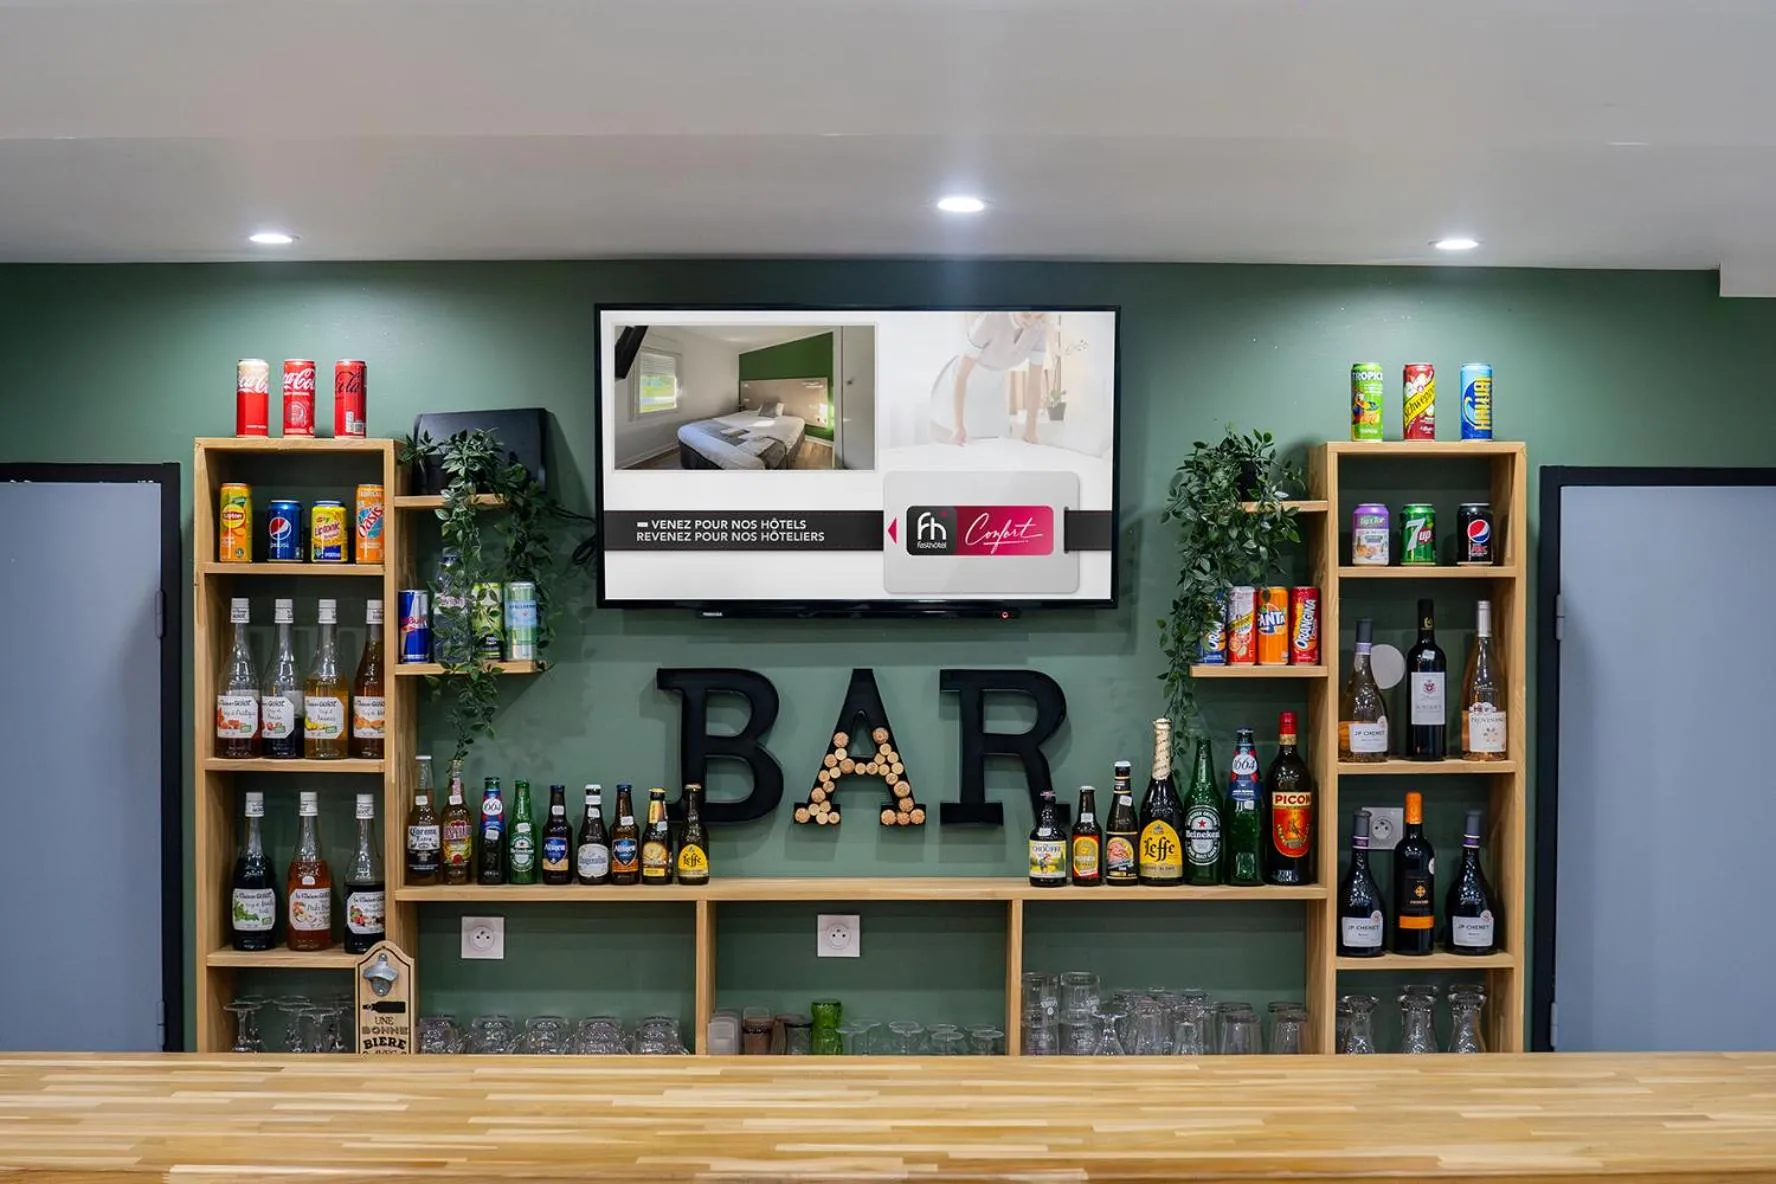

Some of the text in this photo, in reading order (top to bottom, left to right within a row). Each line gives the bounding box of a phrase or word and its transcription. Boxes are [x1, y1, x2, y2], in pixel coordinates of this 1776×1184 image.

[651, 517, 807, 530] VENEZ POUR NOS HÔTELS
[636, 529, 825, 542] REVENEZ POUR NOS HÔTELIERS
[965, 512, 1043, 554] Confort
[656, 667, 1072, 825] BAR
[409, 827, 437, 837] Corona
[1186, 829, 1220, 838] Heineken
[1144, 836, 1175, 862] Leffe
[683, 853, 702, 867] Leffe
[375, 1016, 394, 1025] UNE
[361, 1026, 408, 1035] BONNE
[363, 1036, 407, 1050] BIERE
